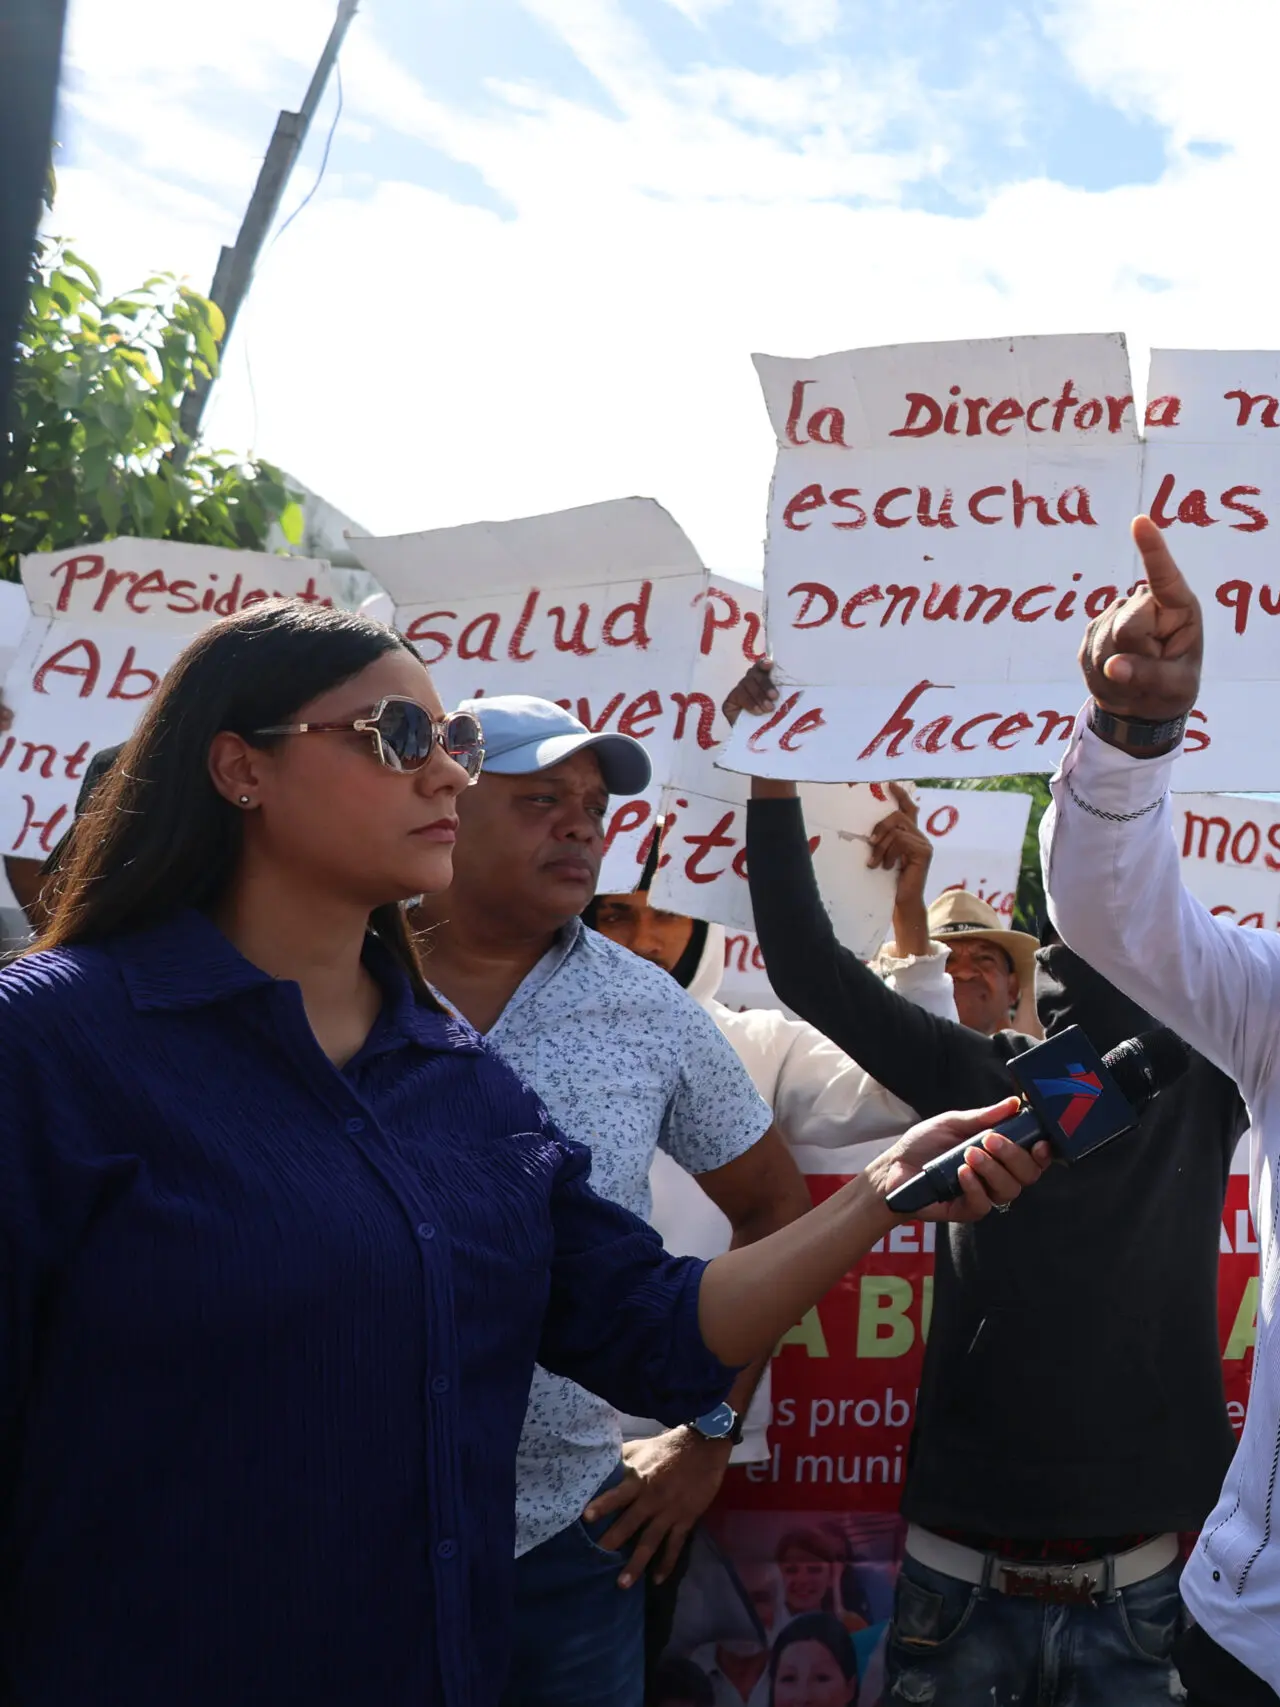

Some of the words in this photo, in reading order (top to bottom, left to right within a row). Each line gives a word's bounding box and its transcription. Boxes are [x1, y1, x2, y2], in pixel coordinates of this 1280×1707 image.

[783, 482, 1098, 531] escucha
[1149, 474, 1269, 532] las
[50, 554, 333, 616] Presidet
[788, 572, 1150, 630] Denuncia
[405, 580, 654, 665] salud
[747, 689, 825, 752] le
[767, 1397, 797, 1426] s
[795, 1444, 902, 1484] muni
